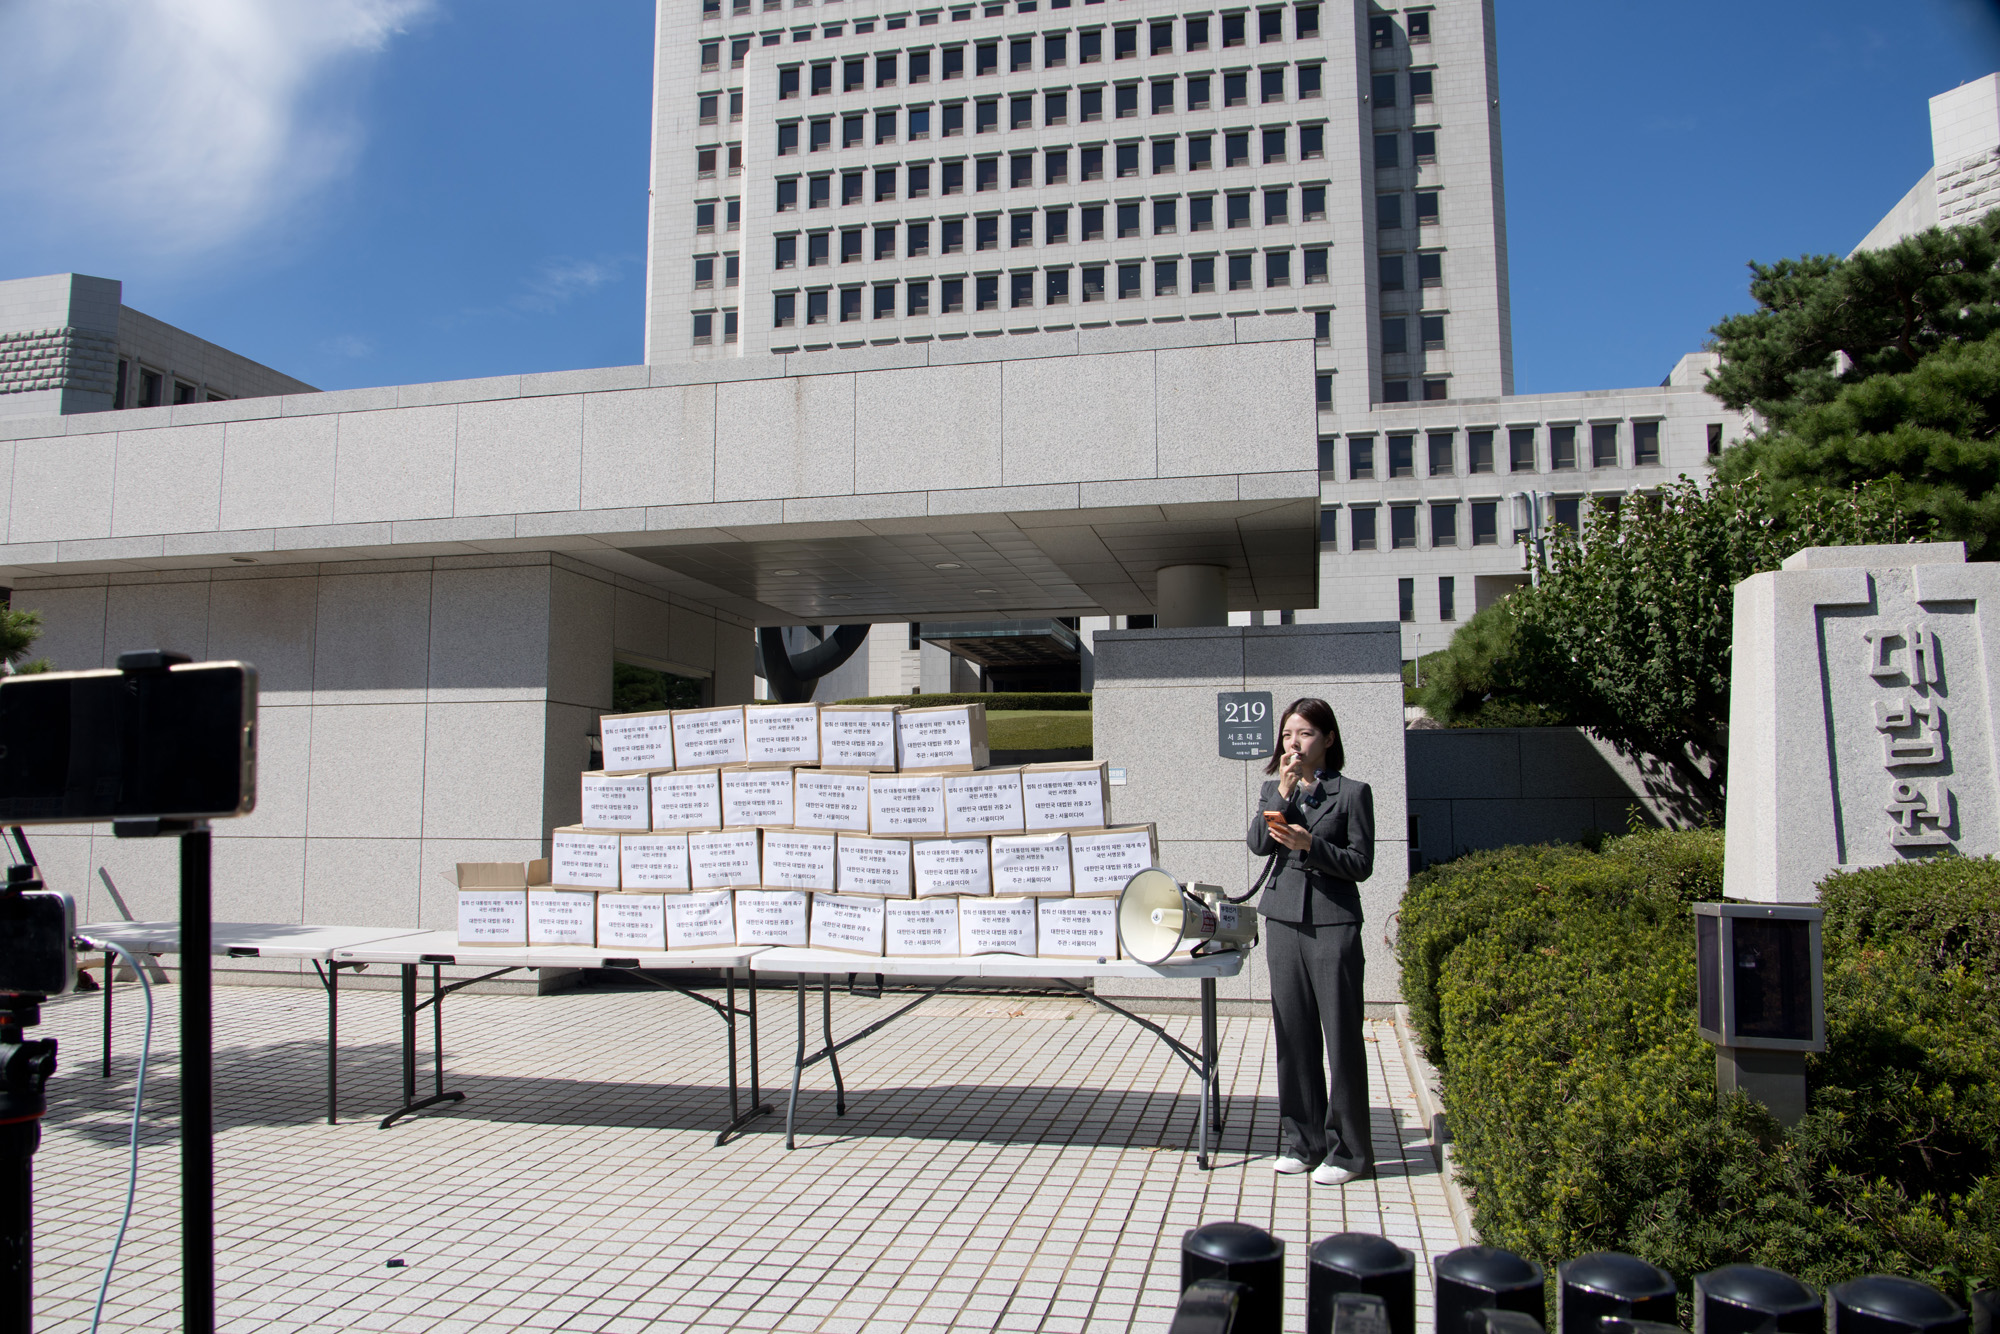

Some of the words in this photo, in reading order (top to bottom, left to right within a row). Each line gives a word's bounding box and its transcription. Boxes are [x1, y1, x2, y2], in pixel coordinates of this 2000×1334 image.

[1224, 702, 1266, 722] 219
[1228, 732, 1262, 740] 서초대로
[1863, 622, 1951, 847] 대법원
